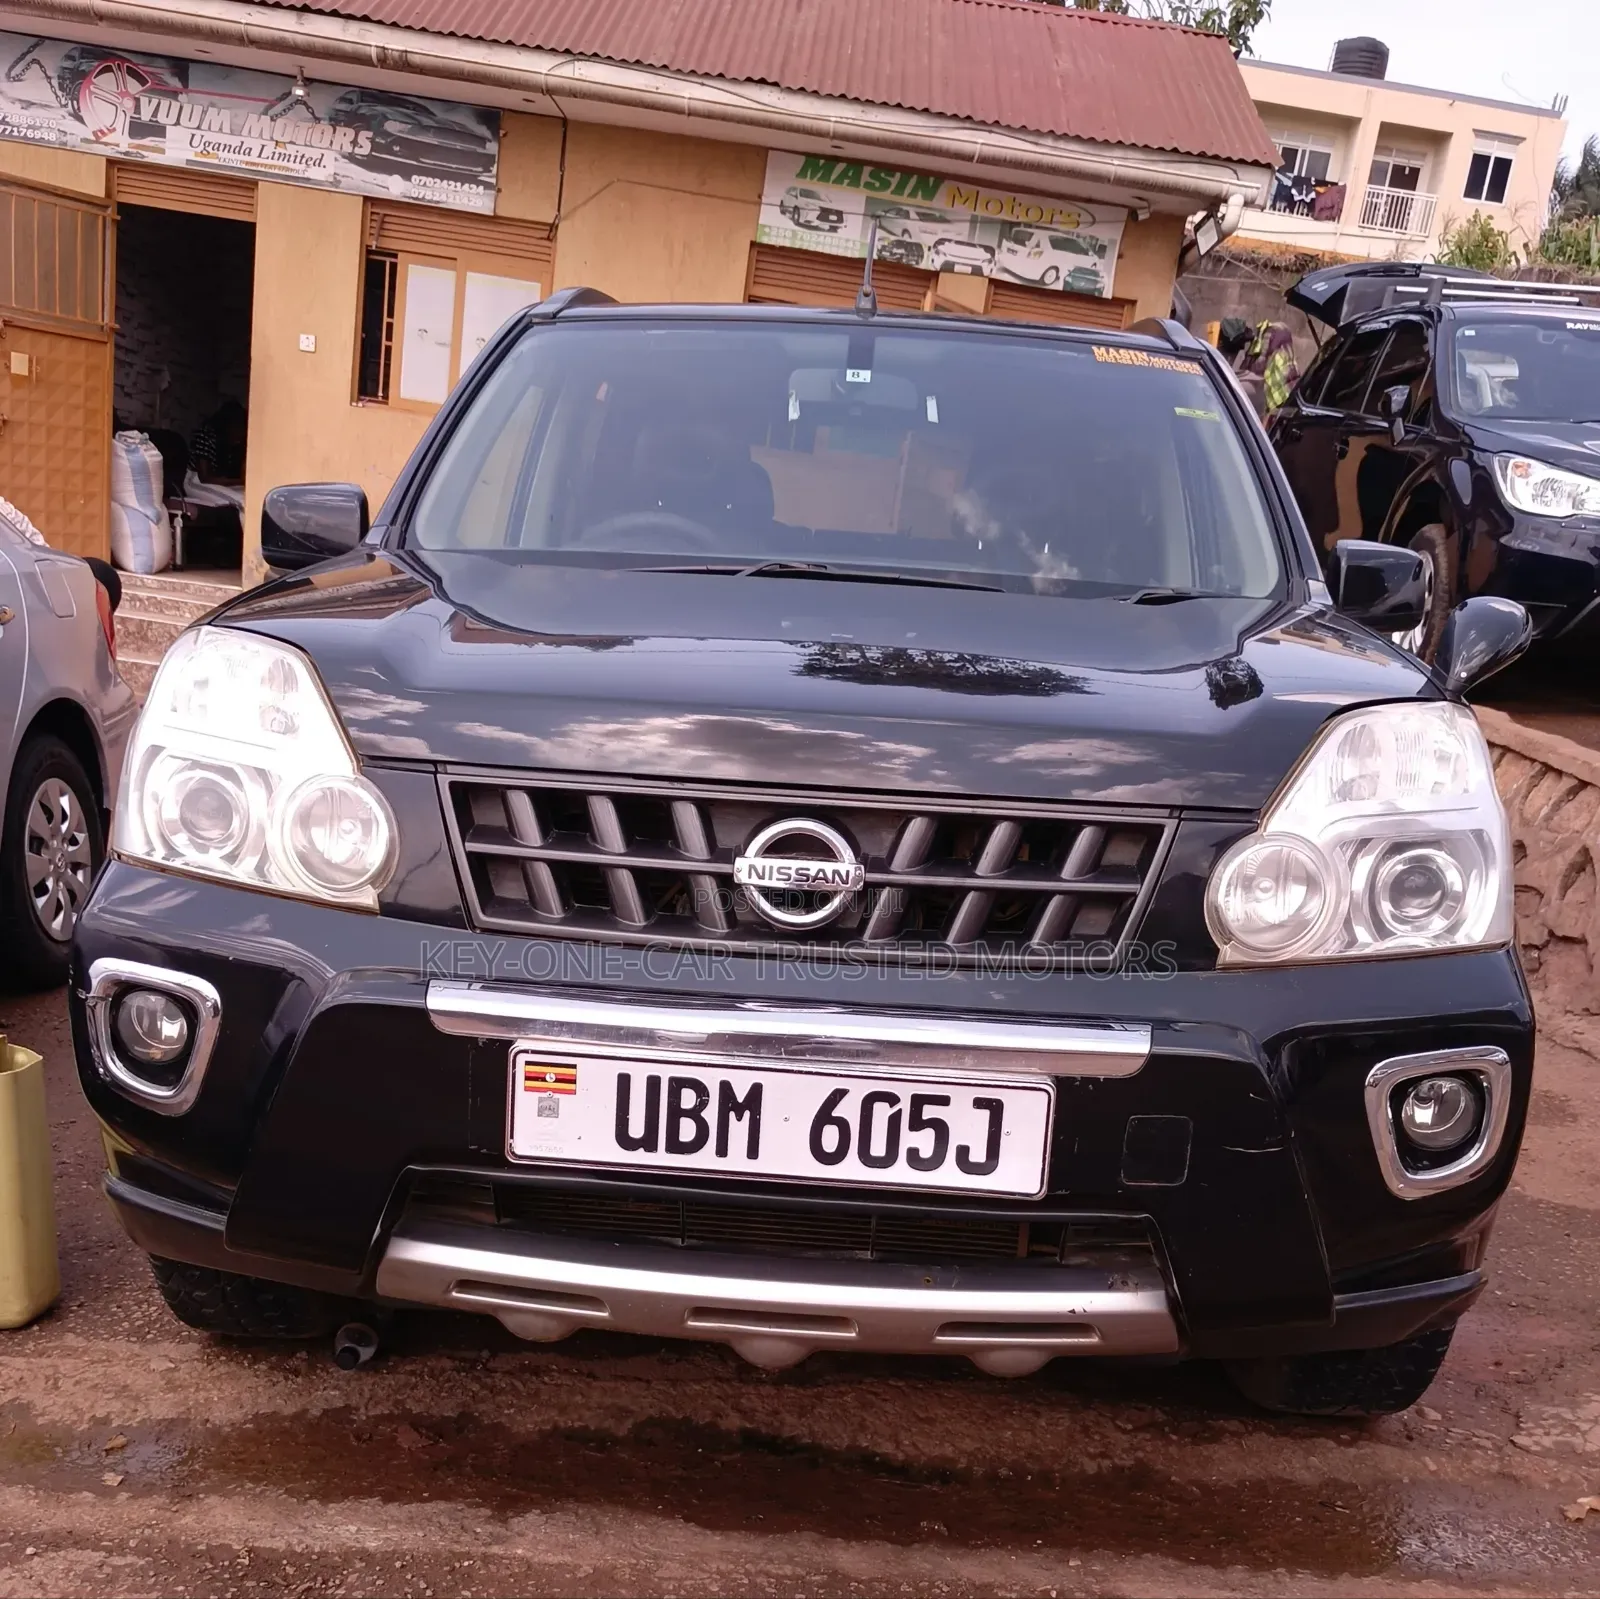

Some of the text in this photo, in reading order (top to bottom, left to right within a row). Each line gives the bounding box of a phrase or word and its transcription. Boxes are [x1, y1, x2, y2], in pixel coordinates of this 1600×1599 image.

[188, 132, 327, 169] Uganda Limited.
[241, 111, 373, 156] MOTORS
[795, 155, 1082, 230] MASIN Motors
[1092, 346, 1149, 362] MASIN
[748, 863, 850, 885] NISSAN
[613, 1072, 1005, 1176] UBM 605J
